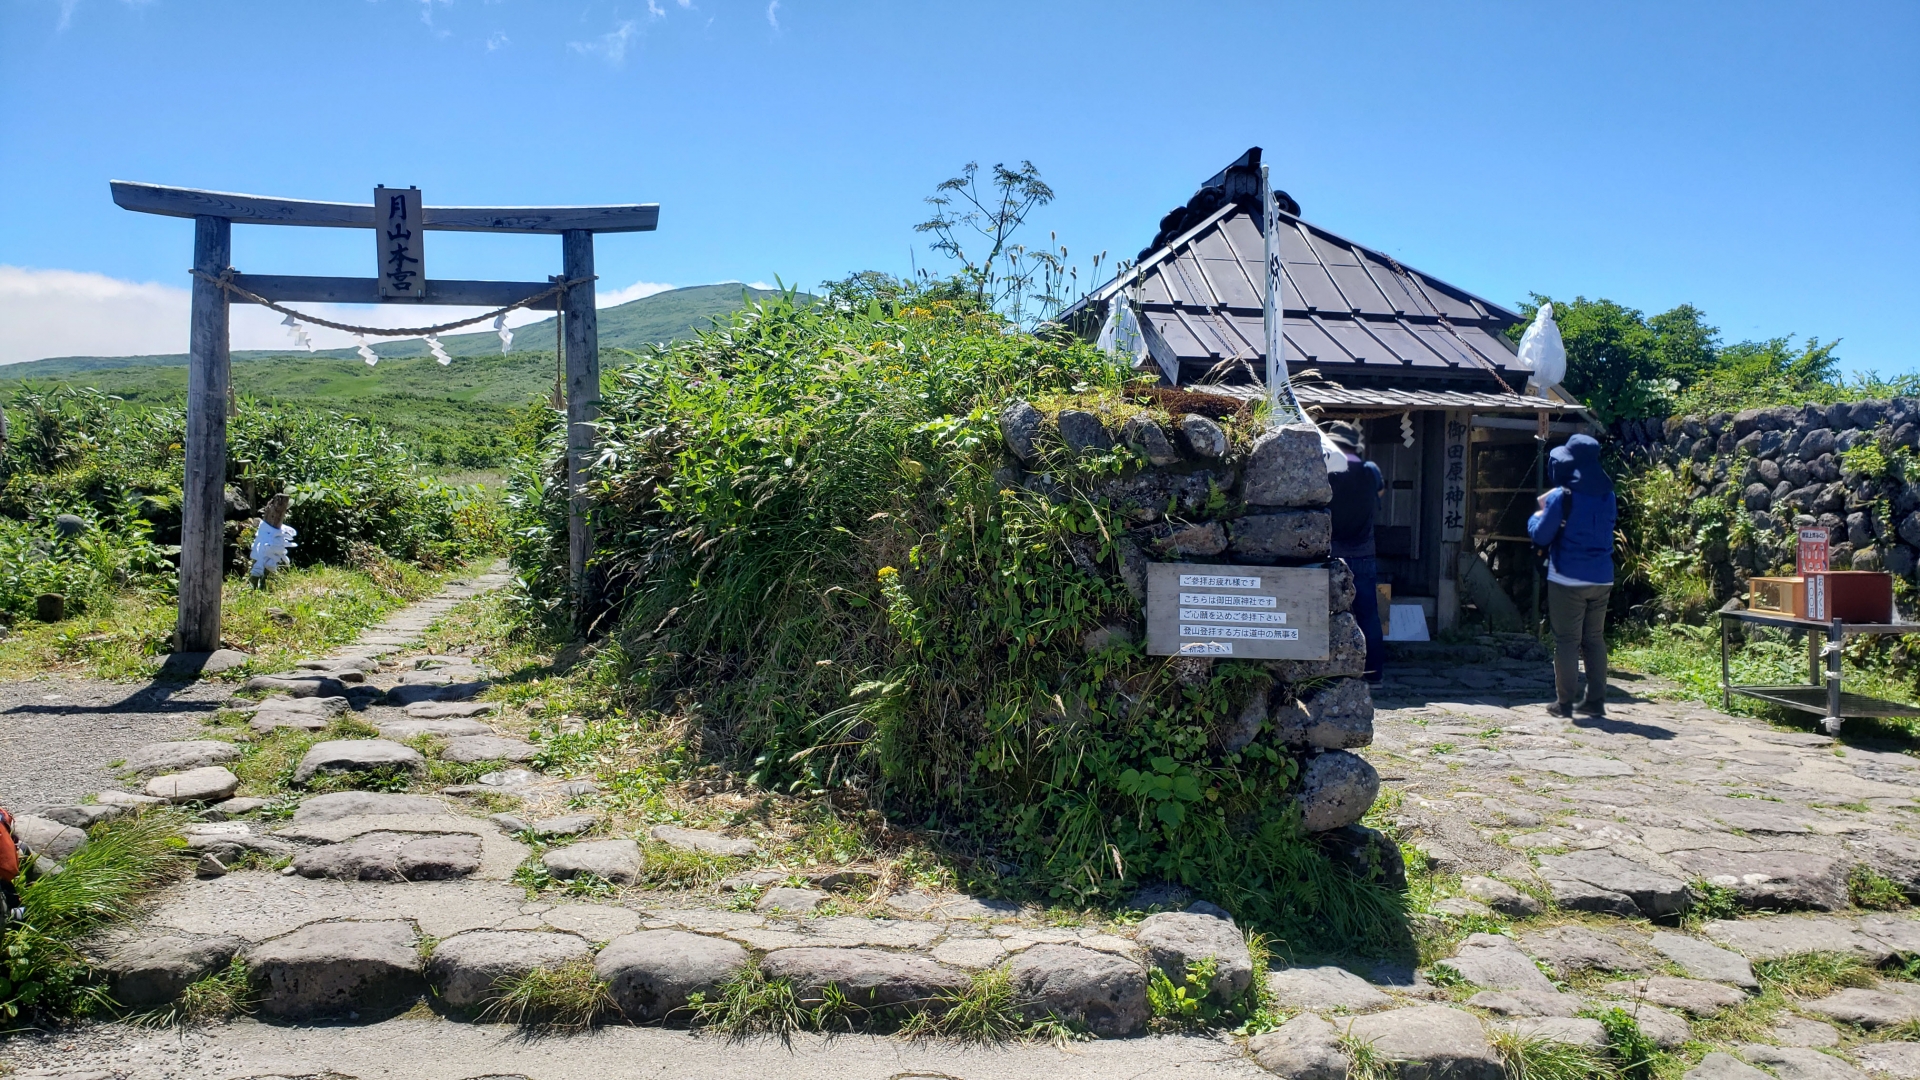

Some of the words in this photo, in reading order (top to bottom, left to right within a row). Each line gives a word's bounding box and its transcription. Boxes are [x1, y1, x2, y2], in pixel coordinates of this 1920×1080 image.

[386, 194, 419, 291] 月山本宮
[1444, 420, 1467, 529] 御田原神社
[1183, 576, 1256, 587] ご参拝お疲れ様です
[1184, 595, 1274, 606] こちらは御田原神社です
[1183, 610, 1282, 622] ご心願を込めご参拝下さい
[1183, 626, 1298, 639] 登山登拝する方は道中の無事を
